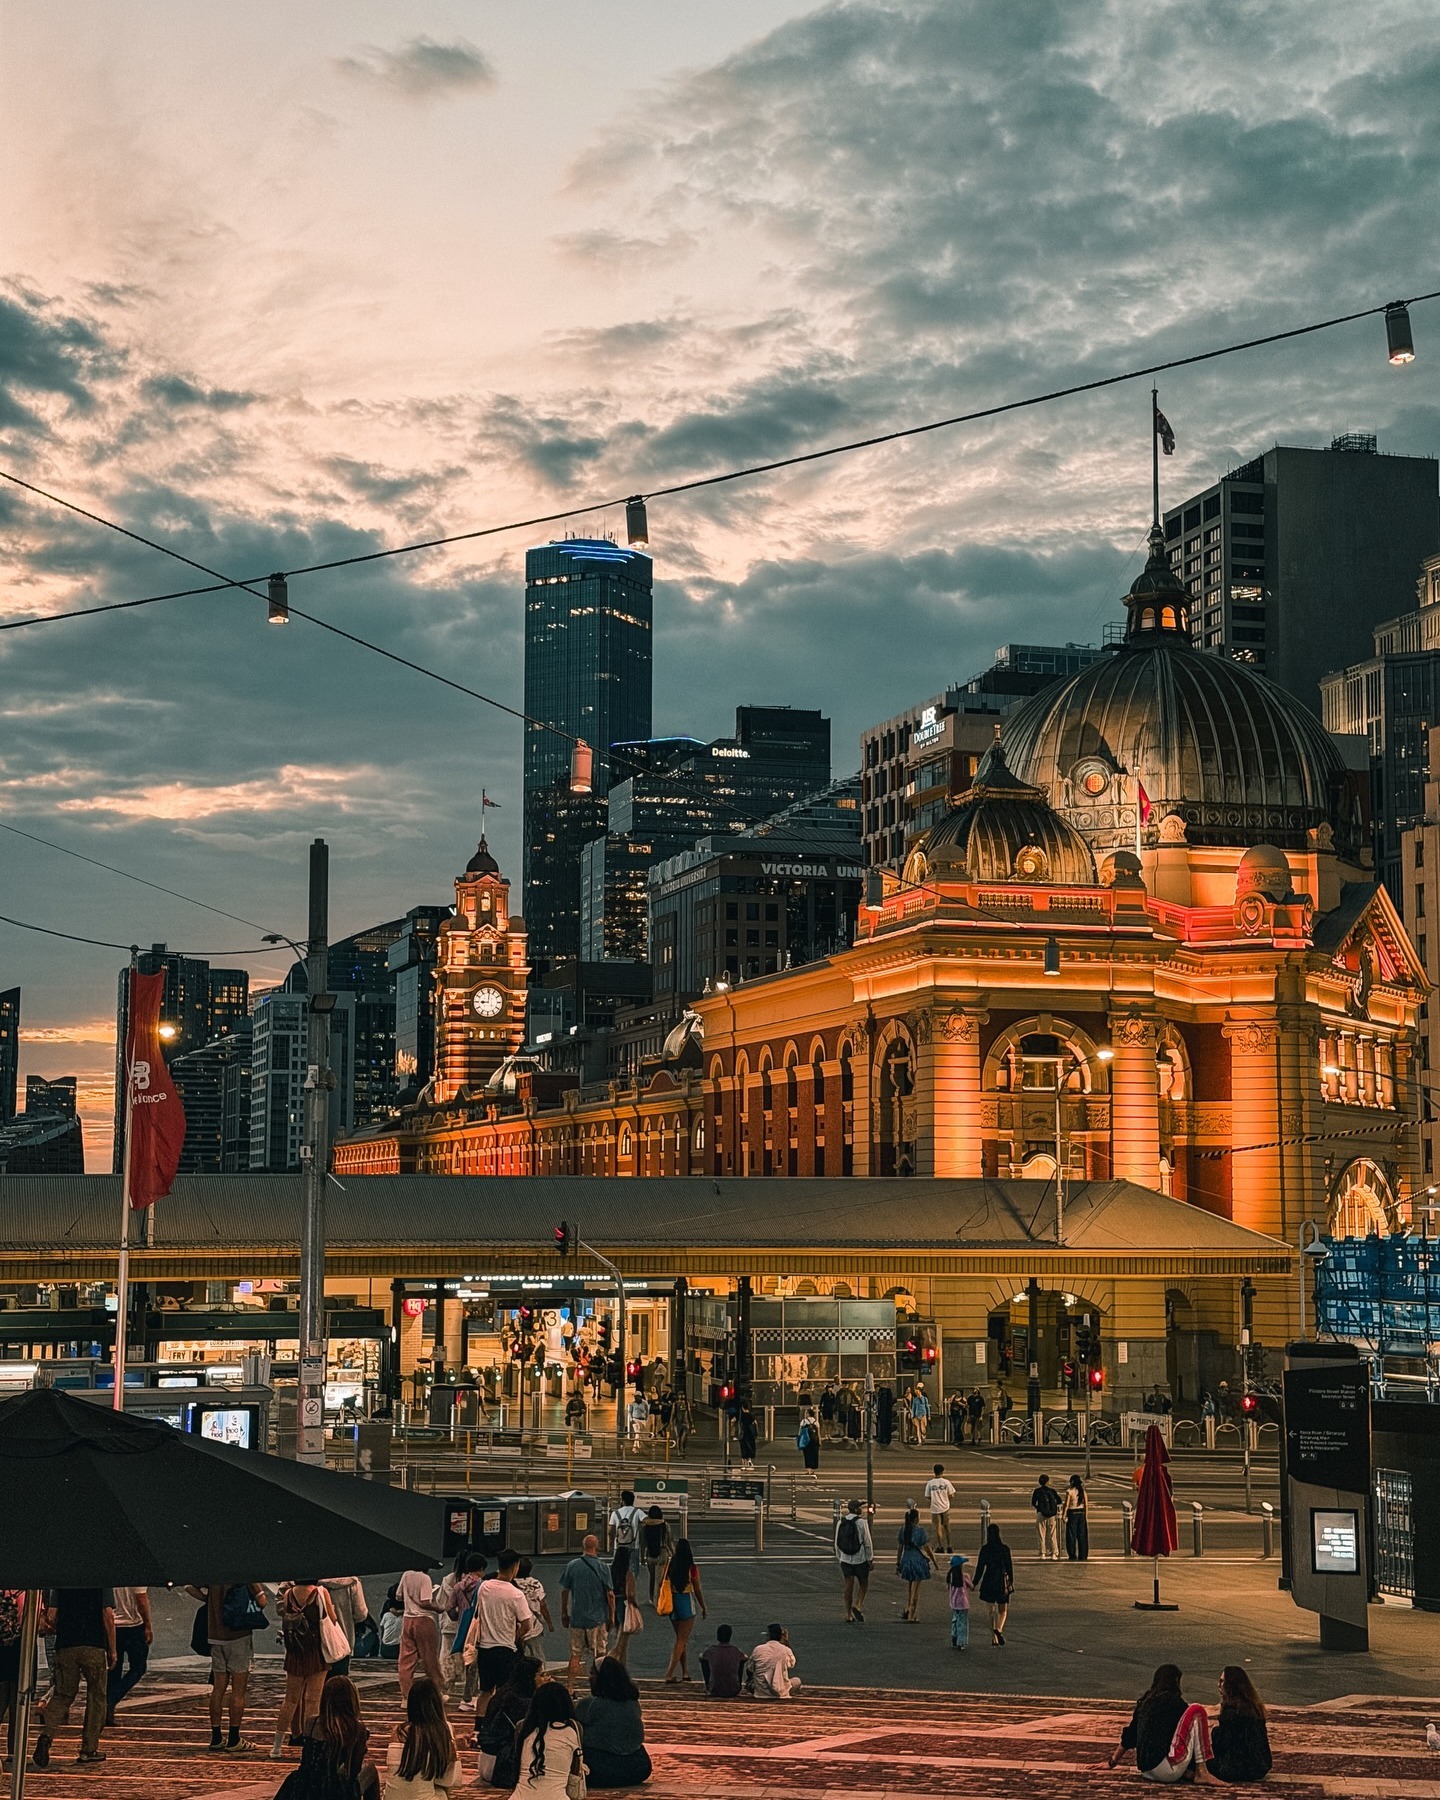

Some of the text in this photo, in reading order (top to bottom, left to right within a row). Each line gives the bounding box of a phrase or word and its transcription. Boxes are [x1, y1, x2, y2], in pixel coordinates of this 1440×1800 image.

[711, 747, 751, 758] Deloitte.
[761, 863, 828, 876] VICTORIA
[172, 1352, 186, 1360] FRY
